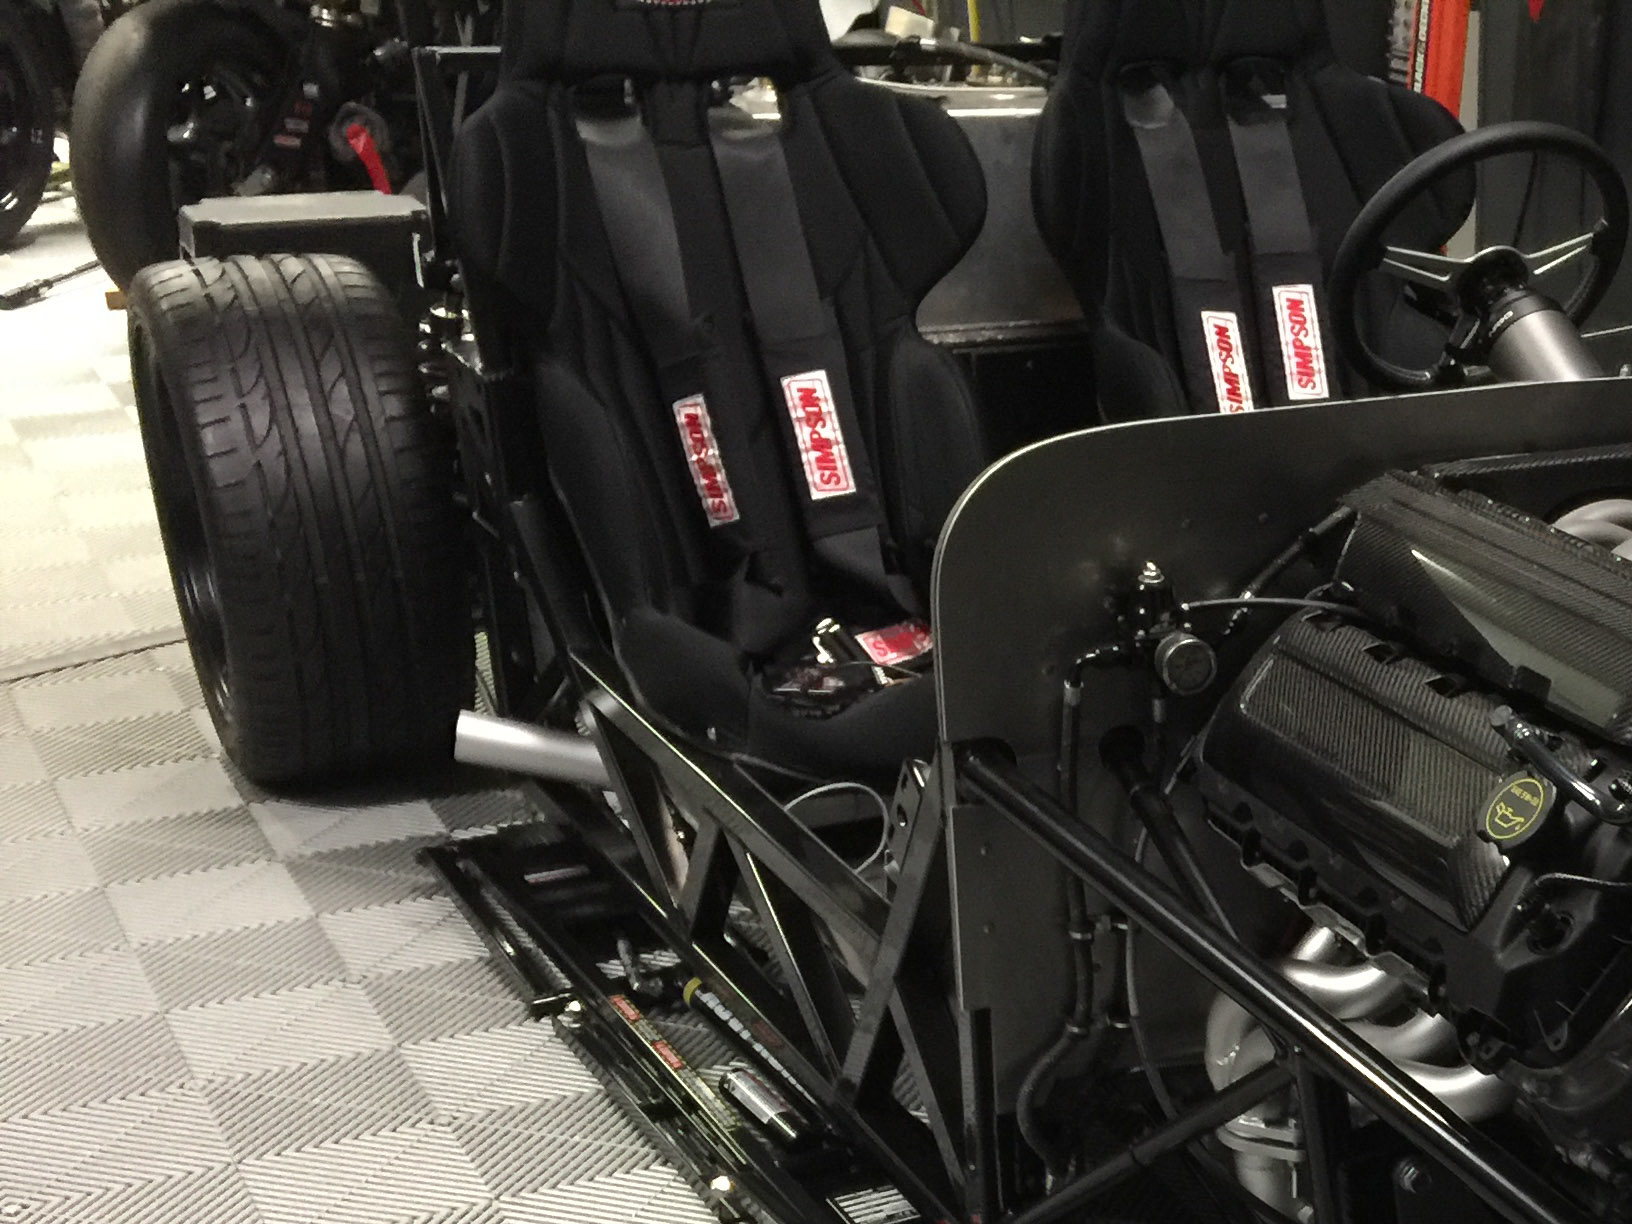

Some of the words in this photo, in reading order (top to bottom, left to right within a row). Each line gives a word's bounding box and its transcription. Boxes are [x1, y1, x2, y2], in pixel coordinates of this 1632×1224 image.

[1213, 323, 1245, 414] SIMPSON
[1286, 298, 1316, 390] SIMPSON
[684, 413, 727, 513] SIMPSON
[797, 388, 842, 485] SIMPSON
